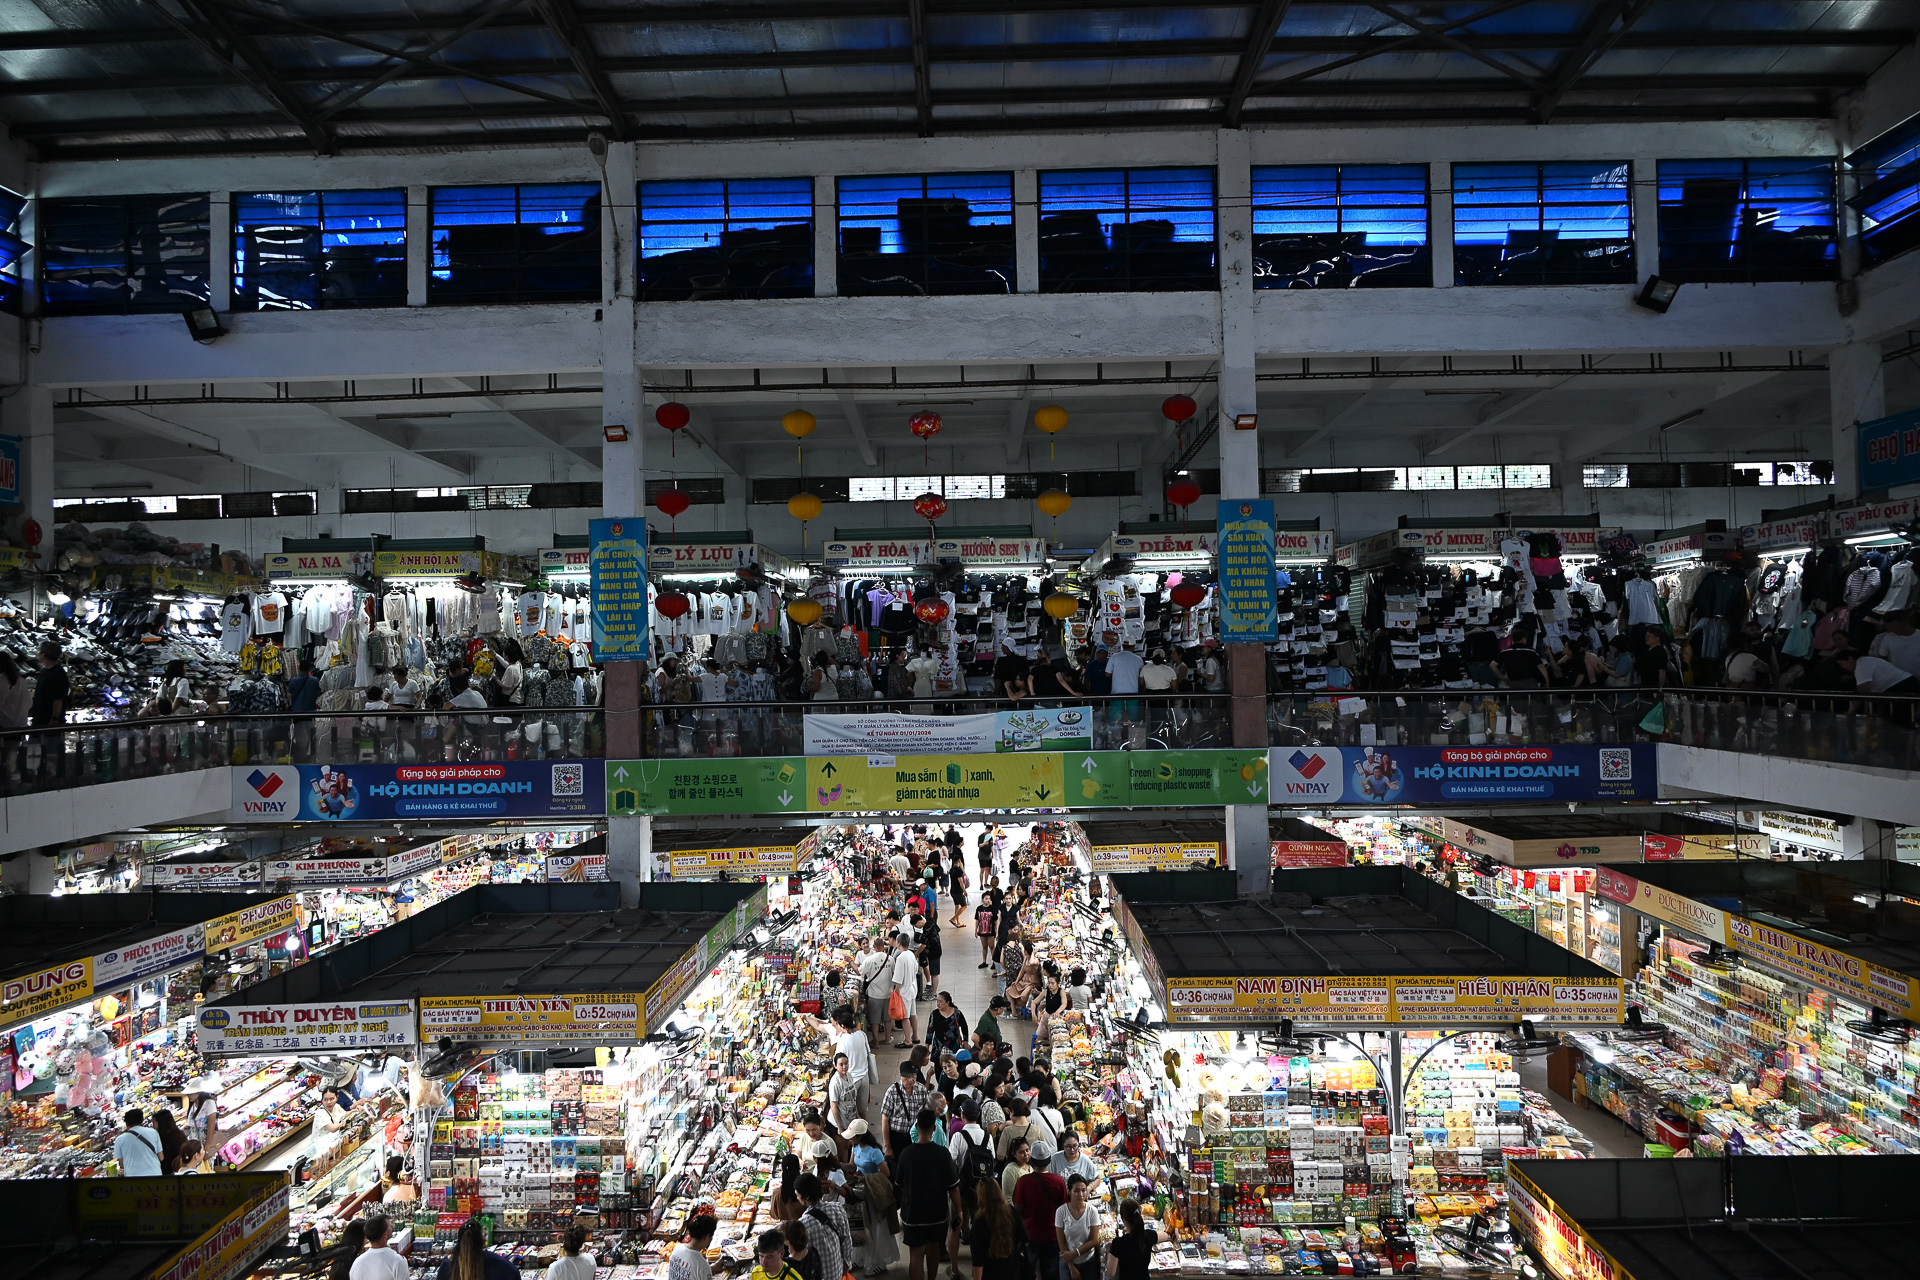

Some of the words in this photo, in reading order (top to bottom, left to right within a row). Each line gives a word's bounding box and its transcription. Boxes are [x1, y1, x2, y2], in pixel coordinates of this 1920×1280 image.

[1868, 430, 1899, 464] CHỢ
[1841, 516, 1855, 531] 158
[1425, 530, 1443, 545] TỐ
[1447, 534, 1484, 545] MINH
[1797, 527, 1814, 542] 159
[851, 542, 873, 557] MỸ
[878, 542, 908, 557] HÒA
[961, 542, 996, 556] HƯƠNG
[1000, 544, 1019, 555] SEN
[1139, 536, 1193, 552] DIỄM
[400, 554, 420, 565] ÁNH
[424, 553, 441, 566] HỘI
[444, 556, 458, 565] AN
[675, 545, 696, 560] LÝ
[701, 546, 733, 562] LỰU
[298, 557, 318, 569] NA
[322, 556, 342, 568] NA
[599, 571, 620, 579] BUÔN
[623, 570, 638, 578] BÁN
[1447, 752, 1468, 761] Tặng
[1471, 752, 1482, 761] bộ
[1486, 751, 1502, 761] giải
[1504, 751, 1527, 760] pháp
[1530, 751, 1547, 759] cho
[402, 769, 424, 779] Tặng
[425, 769, 438, 778] bộ
[440, 769, 456, 778] giải
[458, 768, 481, 778] pháp
[483, 768, 500, 776] cho
[896, 771, 916, 783] Mua
[918, 768, 937, 782] sắm
[970, 769, 995, 782] xanh,
[1130, 768, 1151, 778] Green
[1179, 767, 1213, 778] shopping,
[1414, 763, 1444, 780] HỘ
[1448, 766, 1500, 778] KINH
[1504, 766, 1579, 778] DOANH
[674, 775, 700, 786] 친환경
[703, 775, 737, 785] 쇼핑으로
[1130, 781, 1162, 792] reducing
[1163, 780, 1187, 791] plastic
[1189, 781, 1210, 789] waste
[370, 781, 400, 798] HỘ
[402, 784, 454, 796] KINH
[458, 782, 532, 795] DOANH
[669, 788, 685, 799] 함께
[689, 788, 705, 798] 줄인
[709, 788, 743, 798] 플라스틱
[896, 787, 918, 802] giảm
[920, 787, 936, 799] rác
[938, 786, 956, 799] thải
[957, 786, 980, 800] nhựa
[1286, 783, 1330, 794] VNPAY
[244, 802, 286, 812] VNPAY
[422, 802, 442, 810] HÀNG
[450, 802, 459, 810] KÊ
[479, 800, 497, 809] THUẾ
[710, 852, 734, 861] THU
[737, 849, 755, 859] HÀ
[1131, 845, 1166, 857] THUẬN
[1168, 843, 1181, 854] VỸ
[174, 866, 193, 875] DÌ
[198, 865, 233, 874] CÚC
[318, 861, 360, 871] PHƯỢNG
[240, 897, 293, 926] PHƯƠNG
[1659, 893, 1676, 909] ĐỨC
[1676, 899, 1716, 924] THƯƠNG
[123, 941, 150, 962] PHÚC
[152, 934, 184, 951] TƯỜNG
[1756, 926, 1791, 951] THU
[1793, 940, 1860, 977] TRANG
[4, 963, 85, 1002] DUNG
[1197, 979, 1213, 987] THỰC
[1236, 978, 1276, 995] NAM
[1280, 978, 1326, 997] ĐỊNH
[1458, 977, 1498, 996] HIẾU
[1502, 978, 1550, 997] NHÂN
[0, 992, 52, 1014] SOUVENIR
[55, 988, 61, 996] &
[64, 980, 87, 994] TOYS
[1172, 990, 1202, 1003] LÔ:36
[1204, 992, 1218, 1002] CHỢ
[1219, 991, 1232, 1000] HÀN
[1555, 988, 1586, 1001] LÔ:35
[1587, 992, 1602, 1001] CHỢ
[1604, 990, 1617, 1000] HÀN
[17, 1009, 28, 1018] ĐT:
[31, 1002, 47, 1013] 0906
[49, 999, 59, 1008] 179
[60, 994, 72, 1003] 952
[423, 1000, 434, 1008] TẠP
[464, 997, 481, 1005] PHẨM
[483, 996, 537, 1015] THUẬN
[540, 995, 572, 1012] YẾN
[294, 1004, 356, 1022] DUYÊN
[575, 1007, 605, 1019] LÔ:52
[607, 1012, 621, 1020] CHỢ
[622, 1009, 635, 1018] HÀN
[222, 1025, 250, 1037] TRẦM
[252, 1025, 286, 1036] HƯƠNG
[296, 1024, 316, 1035] LƯU
[318, 1023, 341, 1035] NIỆM
[344, 1022, 358, 1032] MỸ
[361, 1020, 388, 1033] NGHỆ
[206, 1040, 225, 1050] 沉香
[235, 1039, 263, 1048] 纪念品
[272, 1038, 300, 1047] 工艺品
